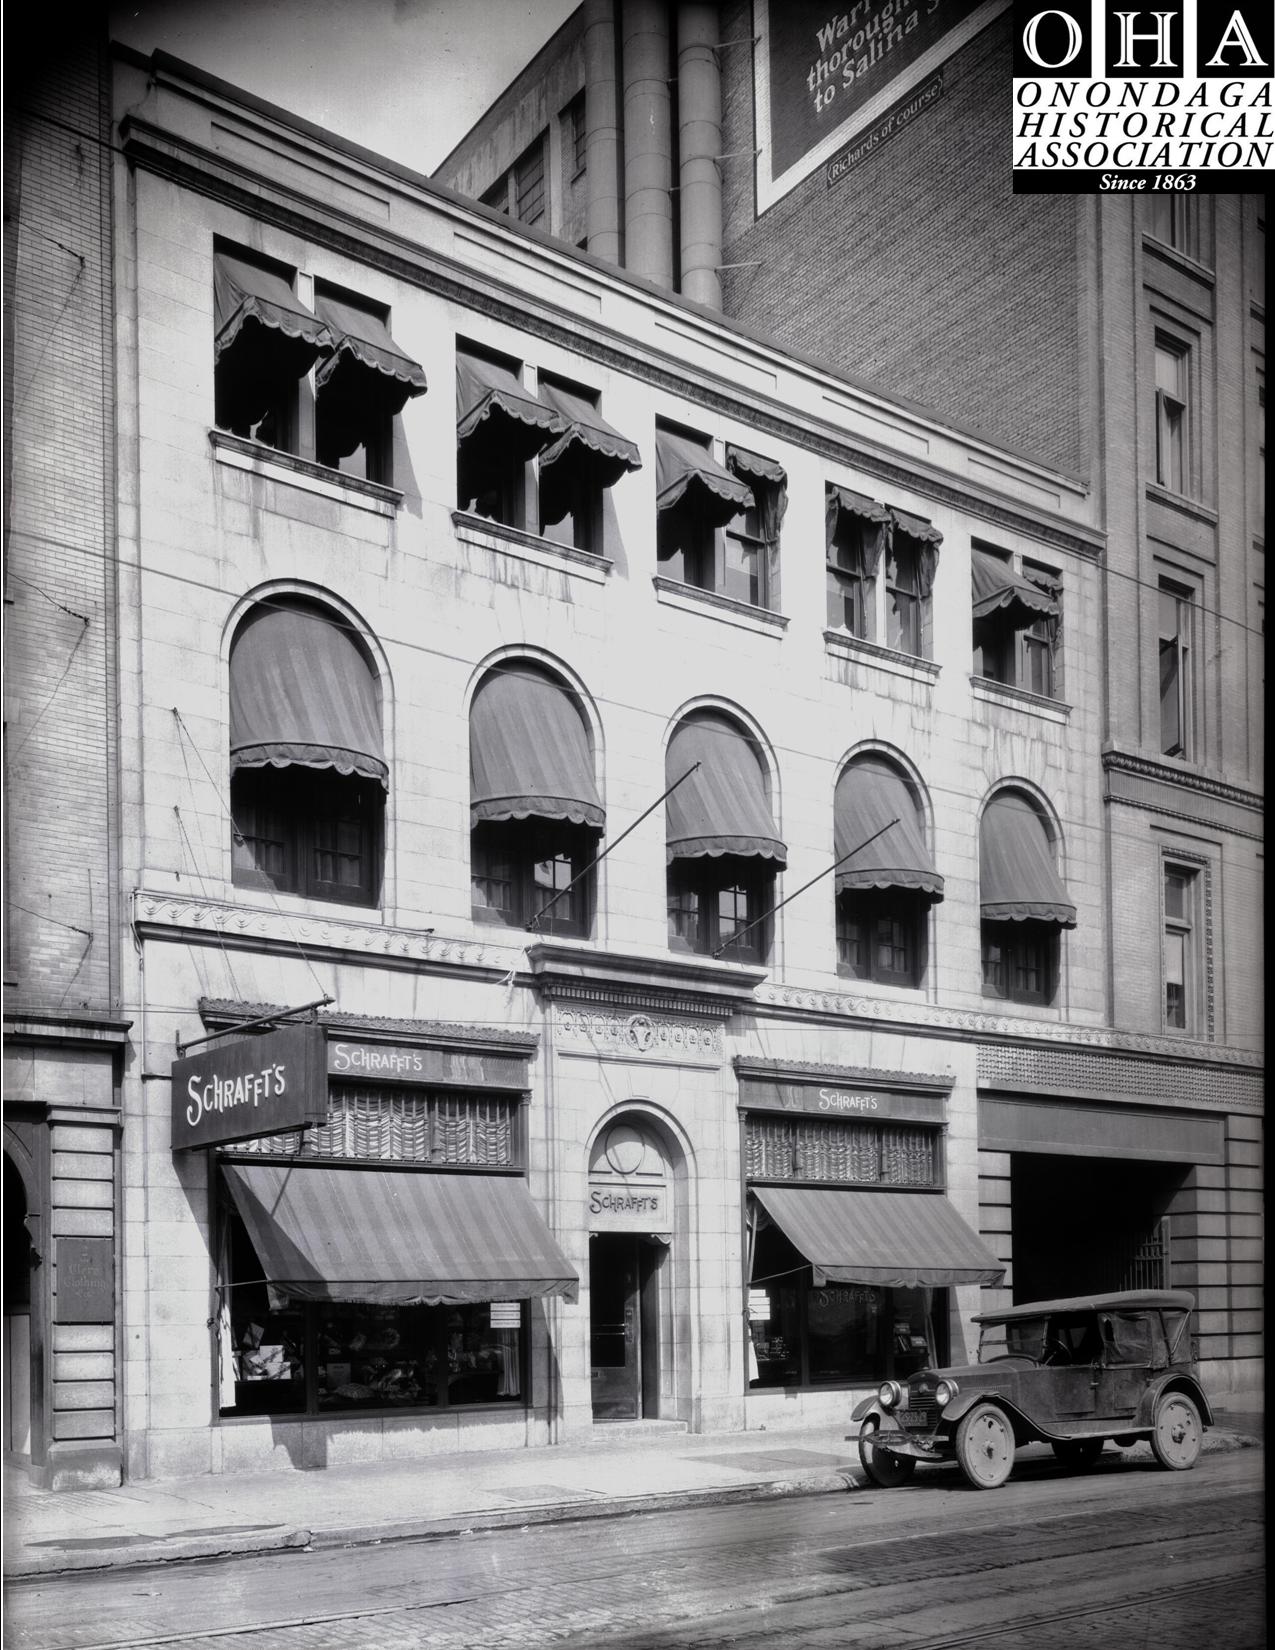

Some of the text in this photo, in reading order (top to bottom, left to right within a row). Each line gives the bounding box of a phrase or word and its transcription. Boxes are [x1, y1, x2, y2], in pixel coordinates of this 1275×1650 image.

[813, 9, 920, 113] to Salina
[831, 85, 938, 178] Richards of course
[333, 1043, 423, 1074] SCHRAFFT'S
[186, 1063, 286, 1127] SCHRAFFT'S
[818, 1088, 878, 1111] SCHRAFFT'S
[589, 1191, 658, 1214] SCHRAFFT'S
